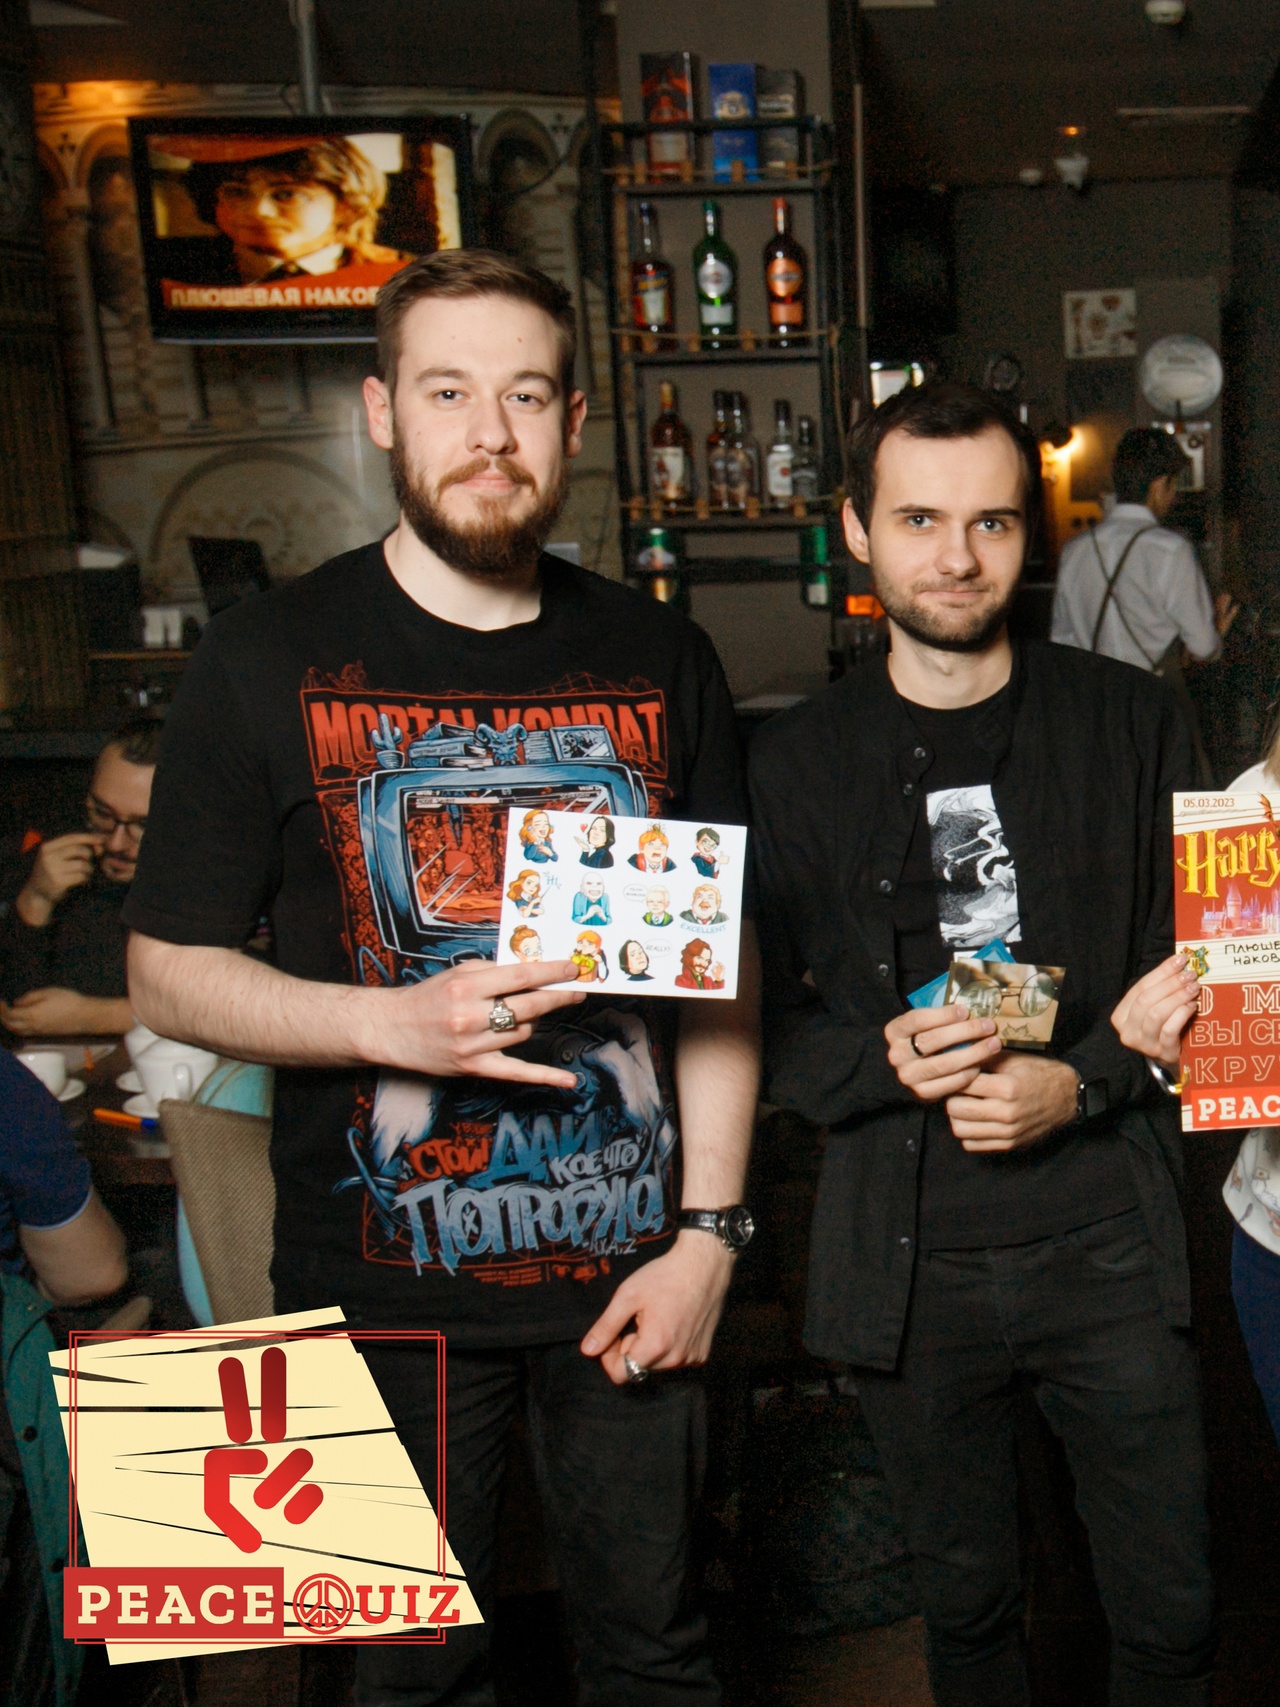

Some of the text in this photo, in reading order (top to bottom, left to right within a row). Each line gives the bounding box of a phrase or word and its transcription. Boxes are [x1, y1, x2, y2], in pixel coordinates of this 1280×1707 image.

[170, 287, 299, 307] ПЛЮШЕВАЯ
[1183, 797, 1235, 808] 05.03.2023
[680, 922, 727, 934] EXCELLENT
[1189, 1019, 1241, 1047] ВЫ
